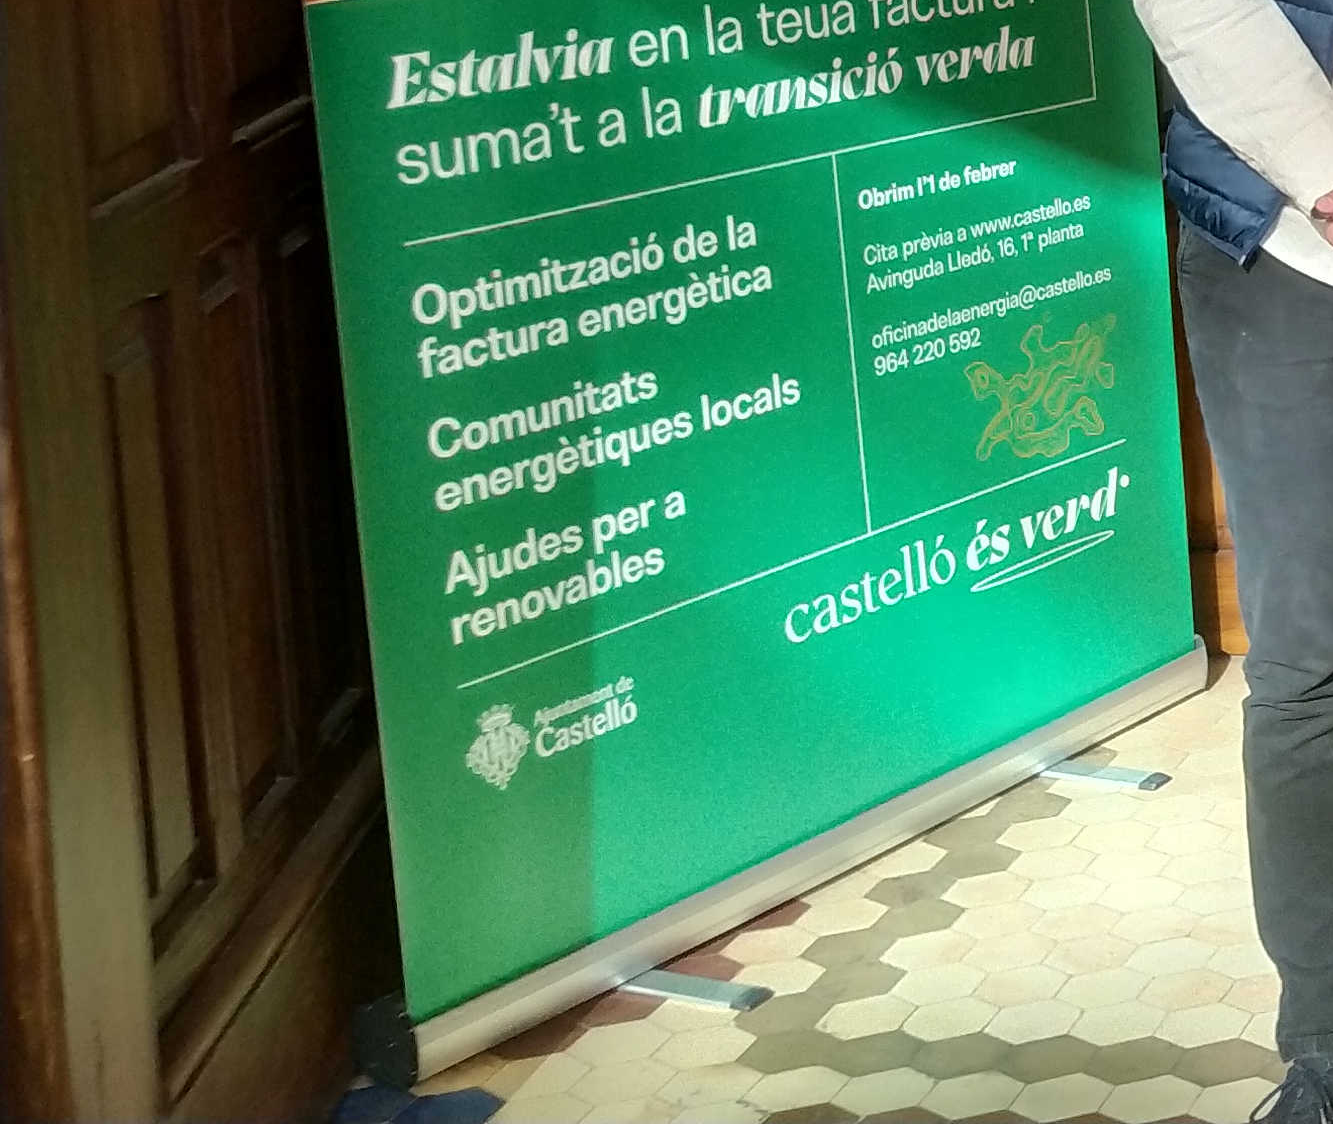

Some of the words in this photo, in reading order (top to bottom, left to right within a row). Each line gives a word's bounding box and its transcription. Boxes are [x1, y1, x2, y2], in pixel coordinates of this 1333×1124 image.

[386, 28, 614, 111] Estalvia
[628, 21, 689, 67] en
[704, 4, 744, 56] la
[396, 101, 584, 185] suma't
[598, 110, 627, 146] a
[641, 86, 683, 137] la
[698, 47, 903, 130] transició
[916, 25, 1036, 88] verda
[858, 183, 914, 210] Obrim
[939, 171, 961, 192] de
[963, 160, 1017, 185] febrer
[864, 244, 898, 266] Cita
[903, 230, 953, 261] prèvia
[957, 227, 967, 242] a
[970, 195, 1091, 238] www.castello.es
[411, 232, 666, 329] Optimització
[674, 225, 718, 264] de
[727, 216, 758, 252] la
[867, 258, 944, 295] Avinguda
[948, 244, 995, 272] Lledó,
[998, 237, 1018, 258] 16,
[1038, 223, 1084, 253] planta
[872, 267, 1111, 349] oficinadelaenergia@castello.es
[417, 309, 569, 378] factura
[579, 262, 773, 337] energètica
[874, 353, 909, 376] 964
[912, 339, 946, 365] 220
[949, 327, 982, 354] 592
[427, 369, 659, 460] Comunitats
[434, 411, 695, 514] energètiques
[701, 373, 801, 432] locals
[443, 529, 584, 596] Ajudes
[592, 503, 657, 557] per
[664, 490, 688, 519] a
[784, 534, 956, 644] castelló
[965, 518, 1011, 573] és
[450, 545, 666, 647] renovables
[535, 695, 638, 757] Castelló
